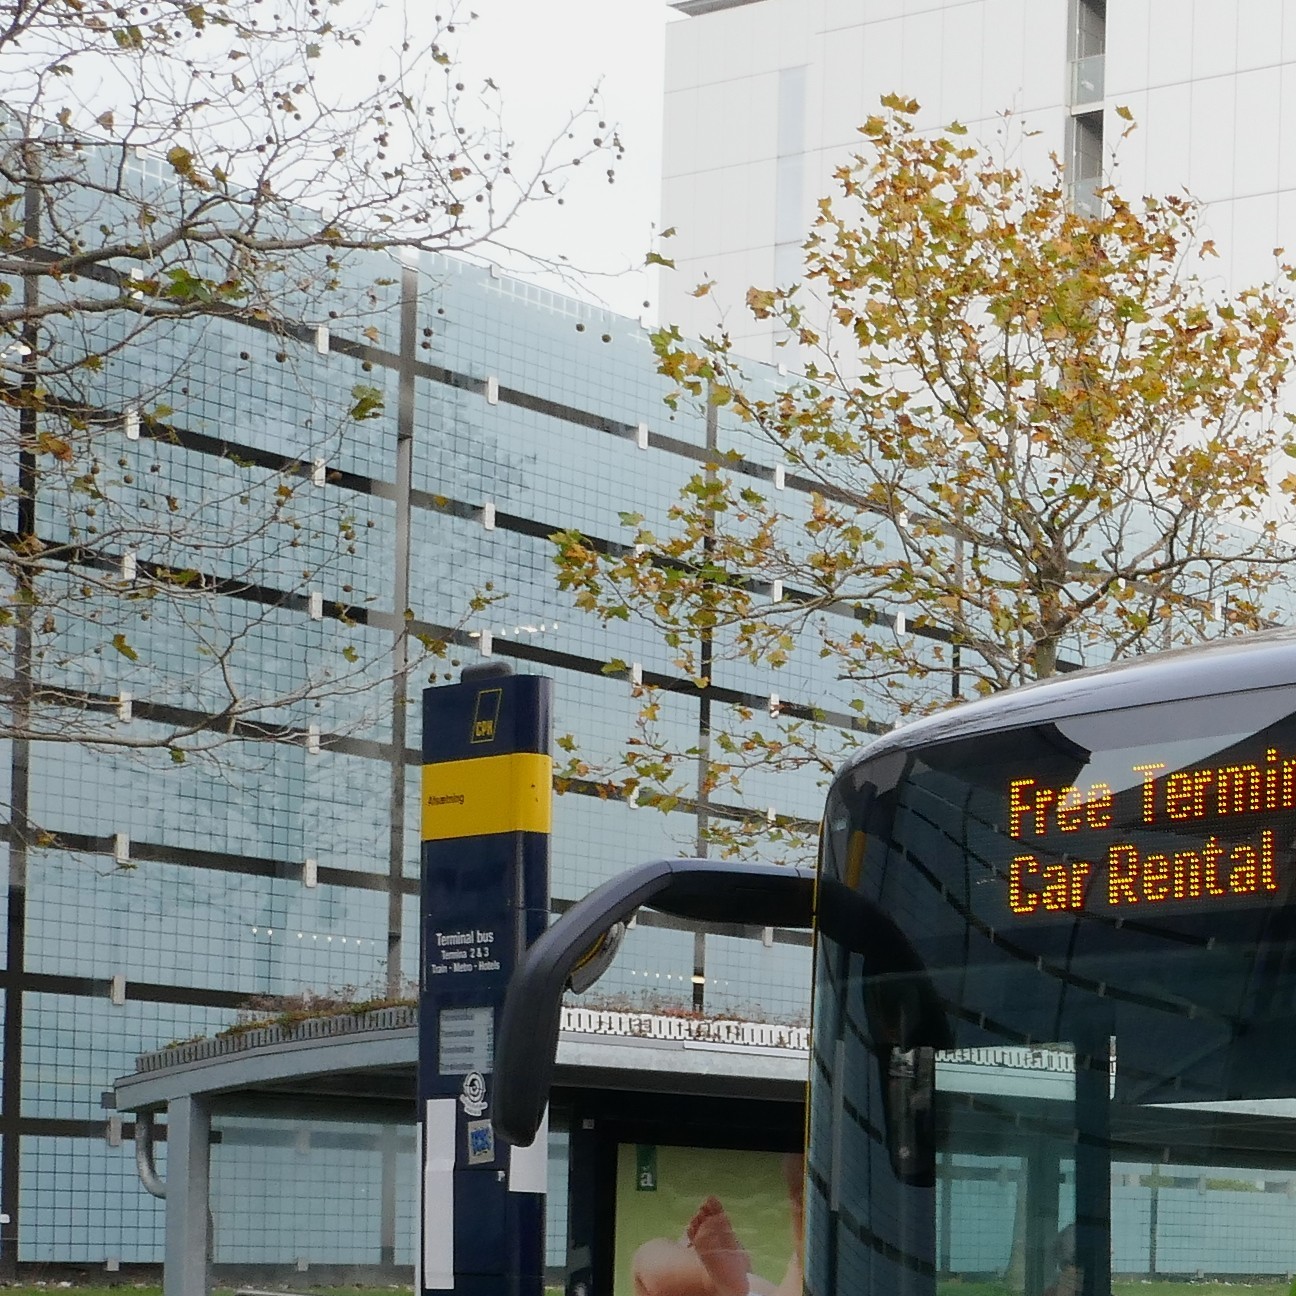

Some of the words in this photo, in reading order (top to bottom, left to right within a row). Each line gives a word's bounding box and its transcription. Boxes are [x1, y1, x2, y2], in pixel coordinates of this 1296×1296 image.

[1008, 777, 1114, 839] Free
[1008, 854, 1091, 914] Car
[1107, 829, 1277, 905] Rental
[435, 930, 475, 947] Terminal
[476, 930, 495, 944] bus
[469, 947, 476, 959] 2
[483, 946, 490, 958] 3
[431, 963, 448, 974] Train
[453, 962, 473, 973] Metro
[478, 960, 501, 971] Hotels
